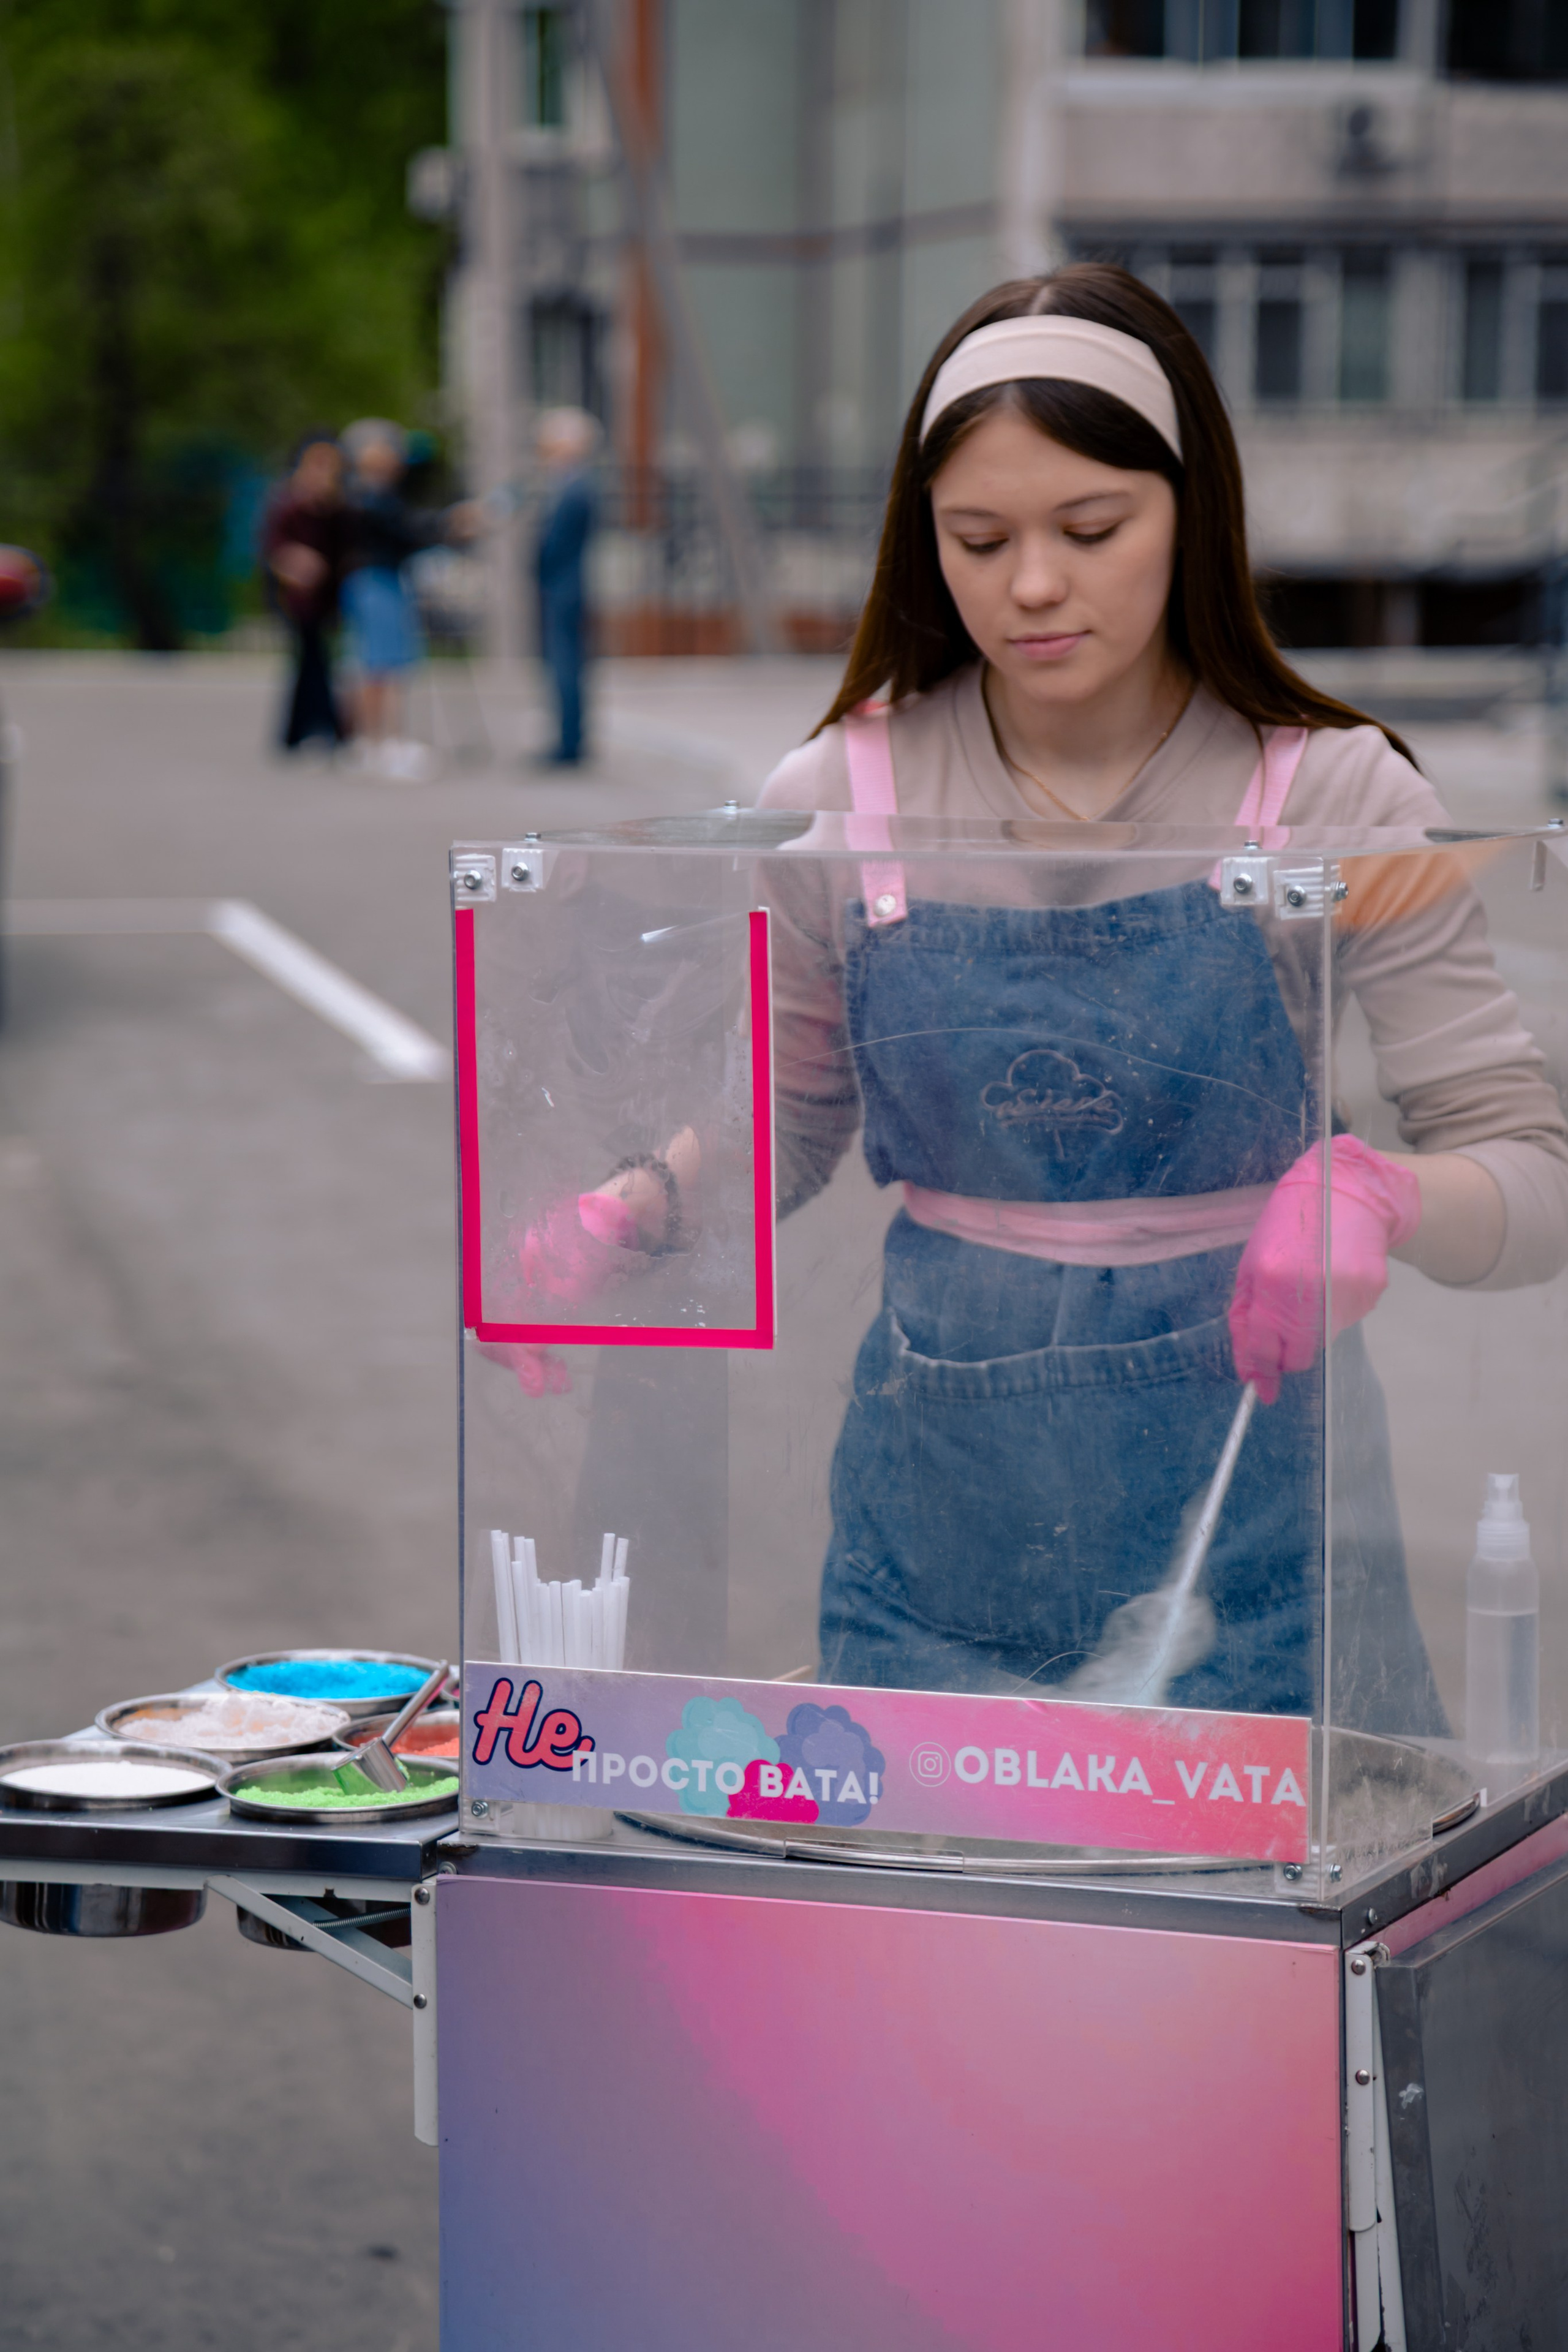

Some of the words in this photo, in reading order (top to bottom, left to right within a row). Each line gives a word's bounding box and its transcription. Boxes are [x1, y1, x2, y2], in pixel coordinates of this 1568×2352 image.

[473, 1678, 595, 1771] Не
[572, 1751, 745, 1793] ПРОСТО
[760, 1765, 879, 1805] ВАТА!
[954, 1746, 1306, 1806] OBLAKA_VATA
